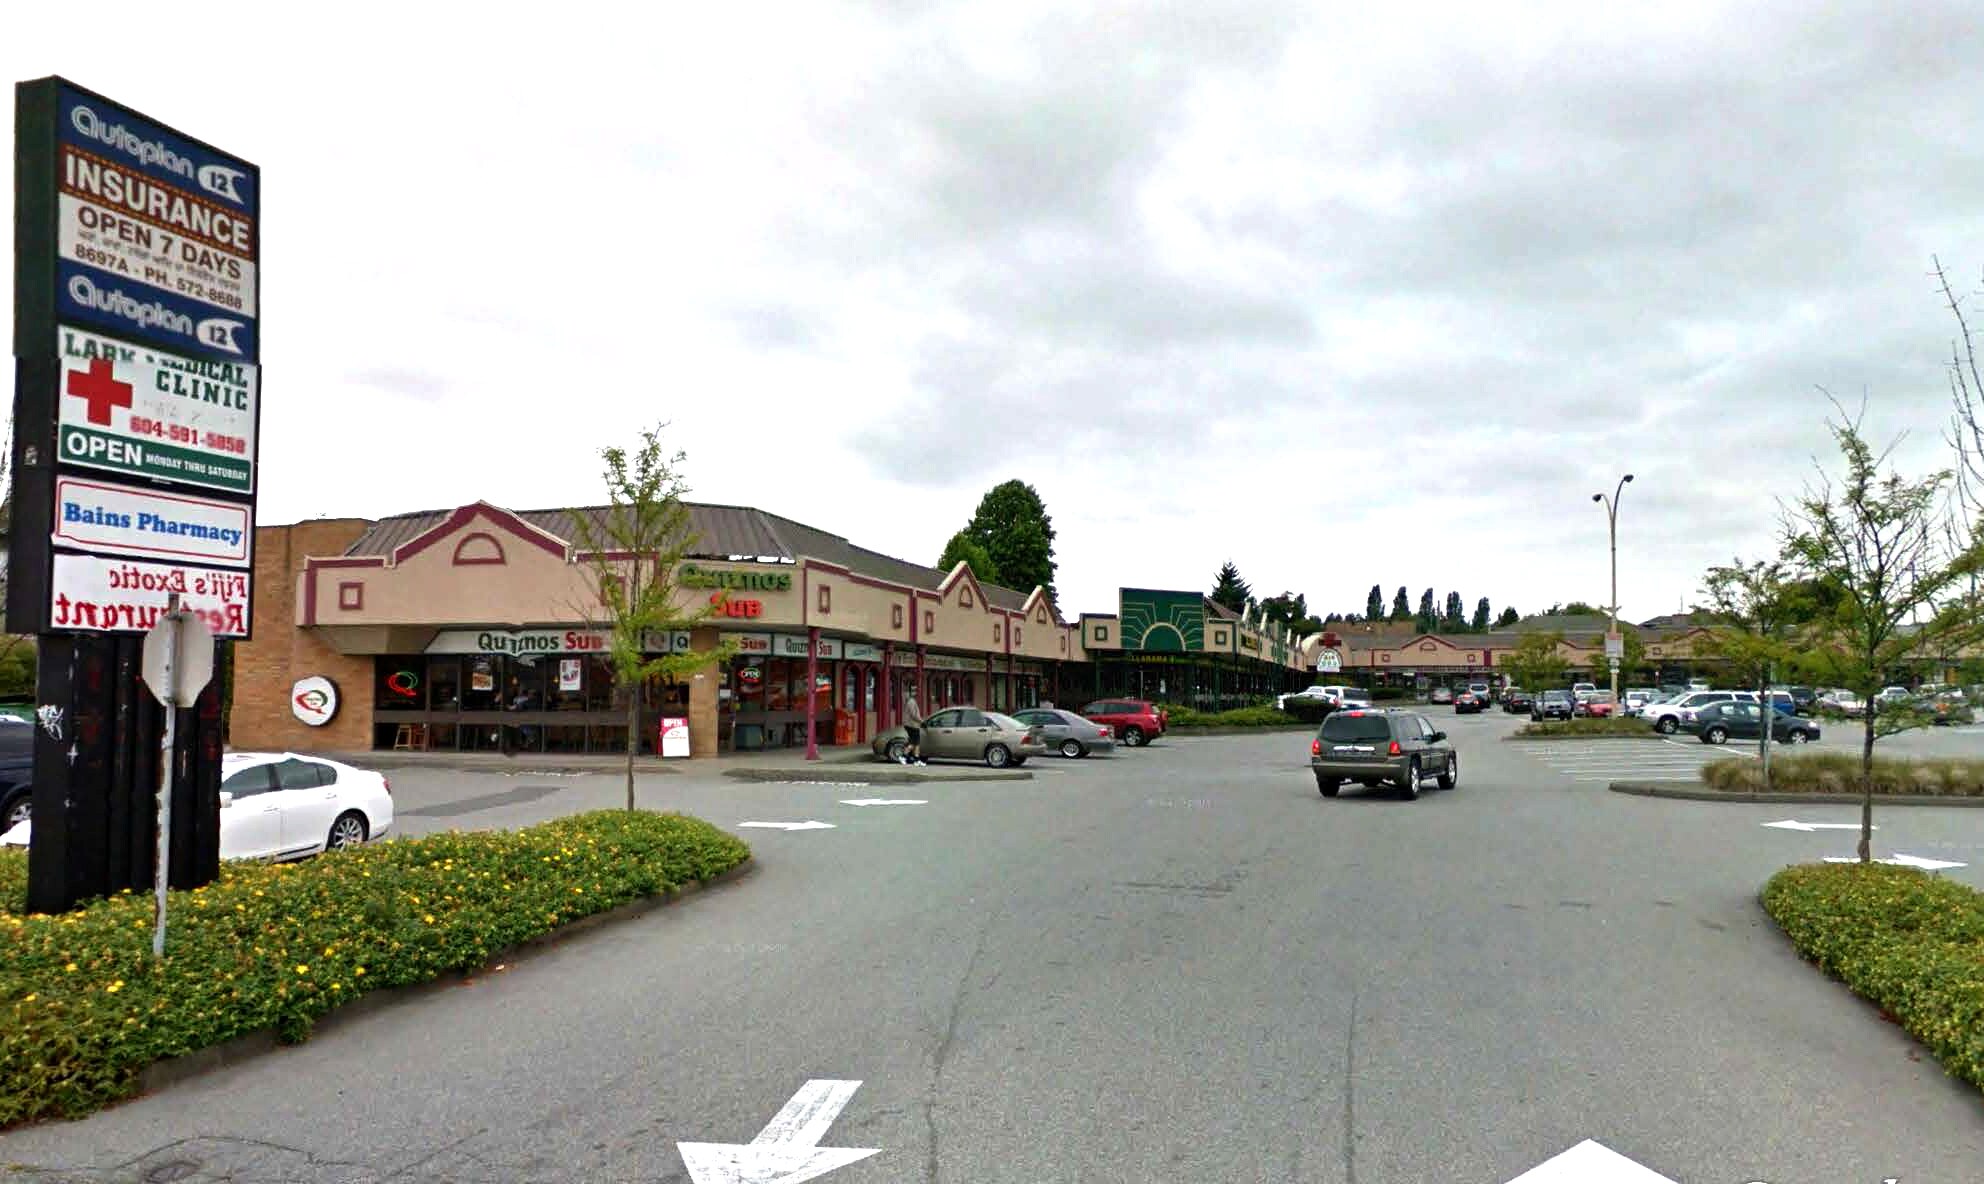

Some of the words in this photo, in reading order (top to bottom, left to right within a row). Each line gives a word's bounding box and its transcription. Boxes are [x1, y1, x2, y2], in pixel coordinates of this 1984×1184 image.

[66, 154, 250, 251] INSURANCE
[210, 171, 229, 191] 12
[78, 205, 151, 249] OPEN
[160, 235, 174, 255] 7
[181, 243, 242, 280] DAYS
[209, 326, 229, 346] 12
[156, 369, 248, 411] CLINIC
[67, 432, 142, 466] OPEN
[146, 454, 181, 469] MONDAY
[184, 460, 206, 474] THRU
[208, 465, 248, 481] SATURDAY
[64, 502, 131, 529] Bains
[136, 512, 243, 546] Pharmacy
